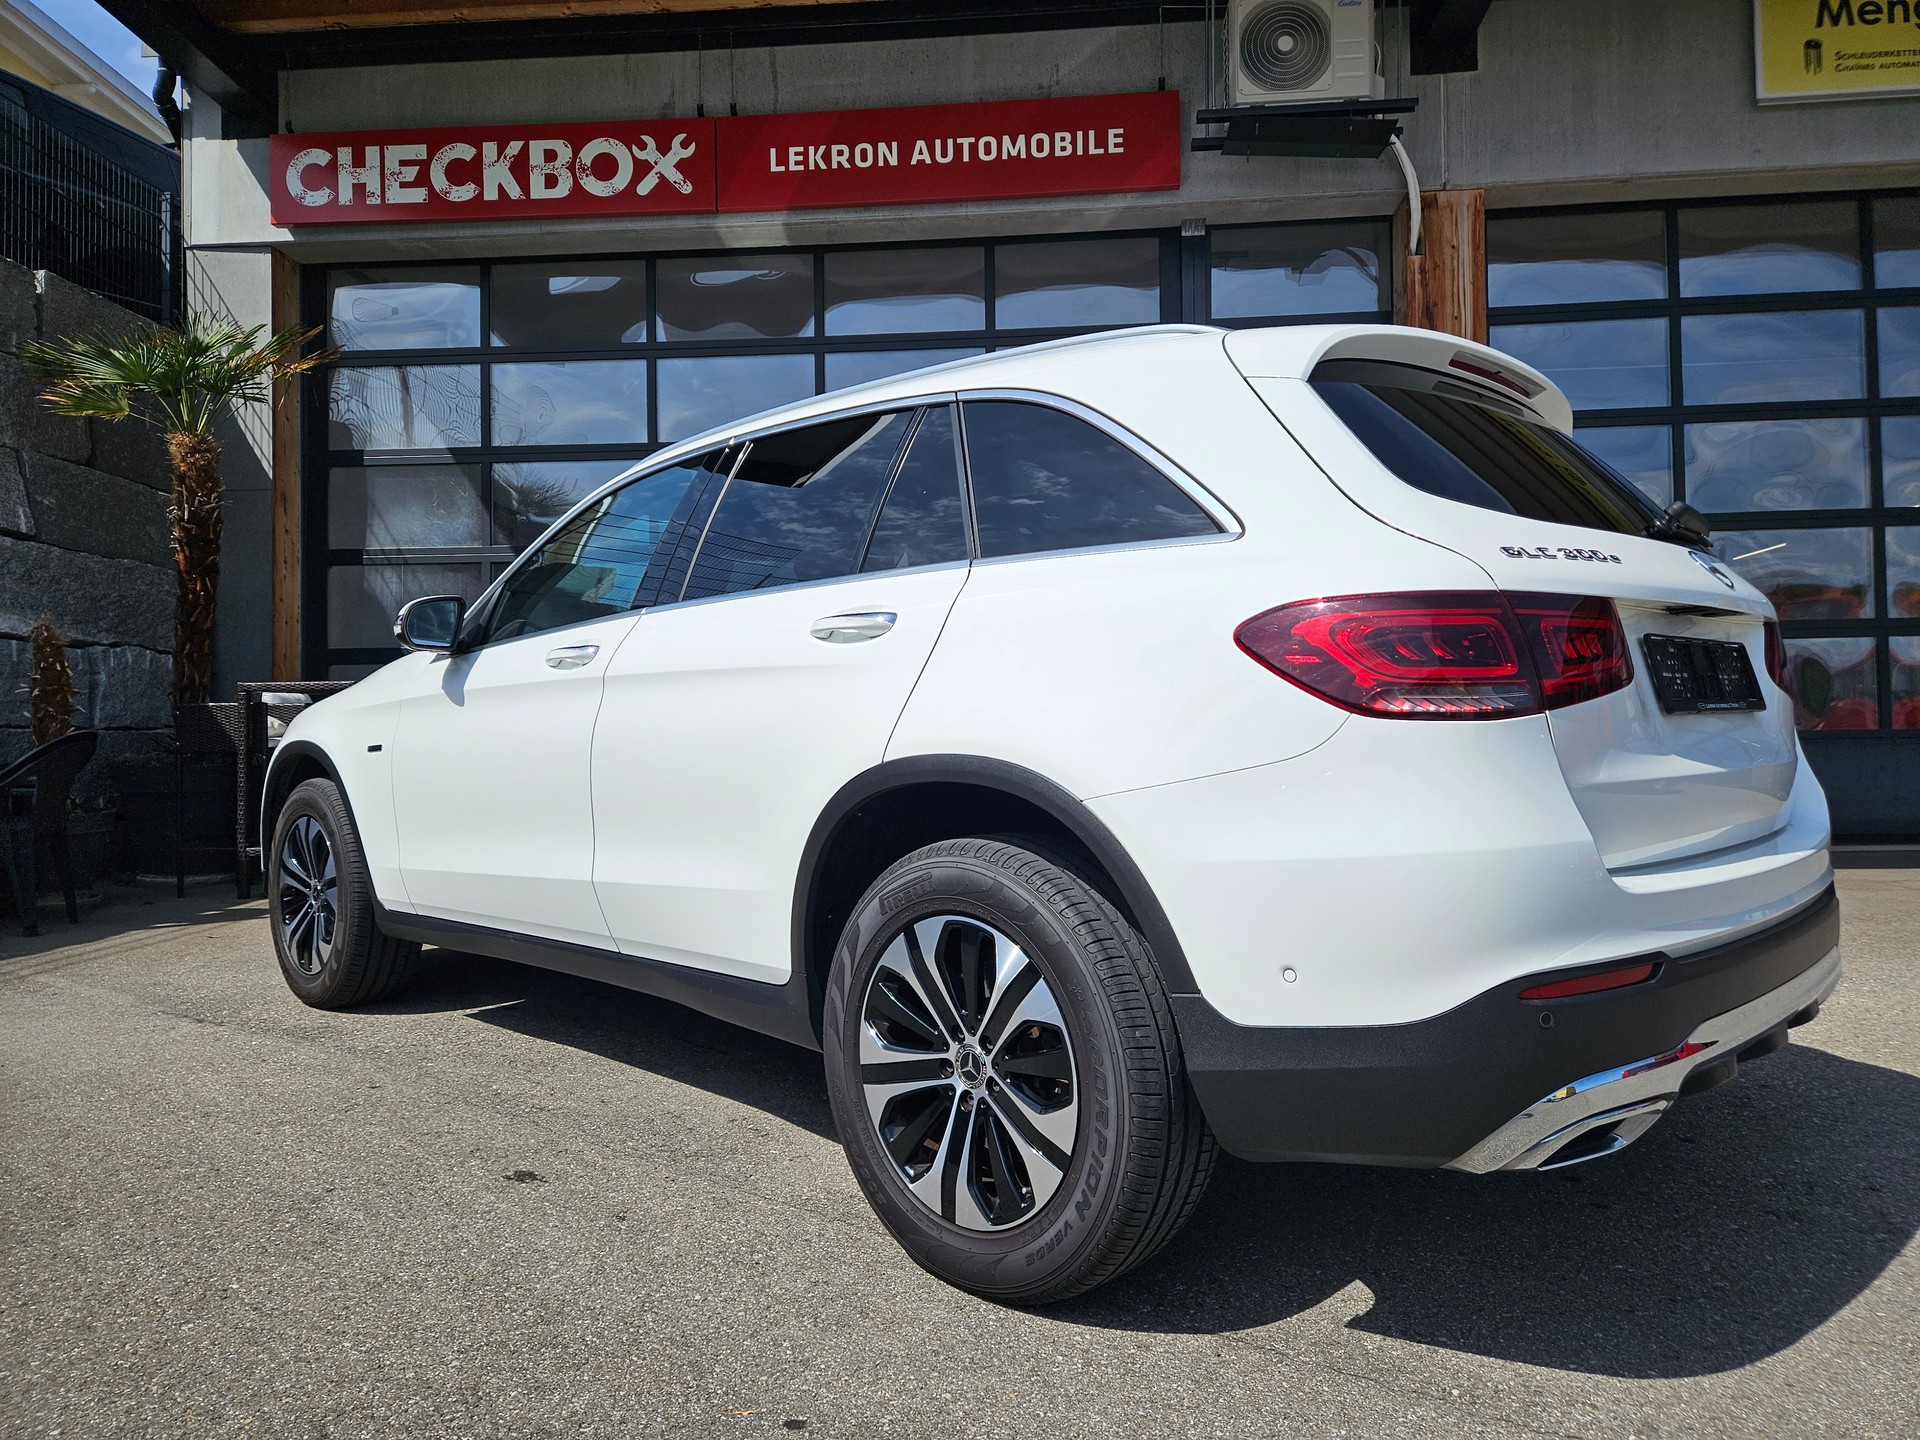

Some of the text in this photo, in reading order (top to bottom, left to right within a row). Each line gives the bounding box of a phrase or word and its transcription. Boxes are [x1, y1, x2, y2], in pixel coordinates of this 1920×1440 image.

[1815, 0, 1920, 30] Men
[769, 128, 1125, 172] LEKRON AUTOMOBILE
[1500, 546, 1557, 559] GLC
[1075, 1008, 1110, 1222] SCORPION
